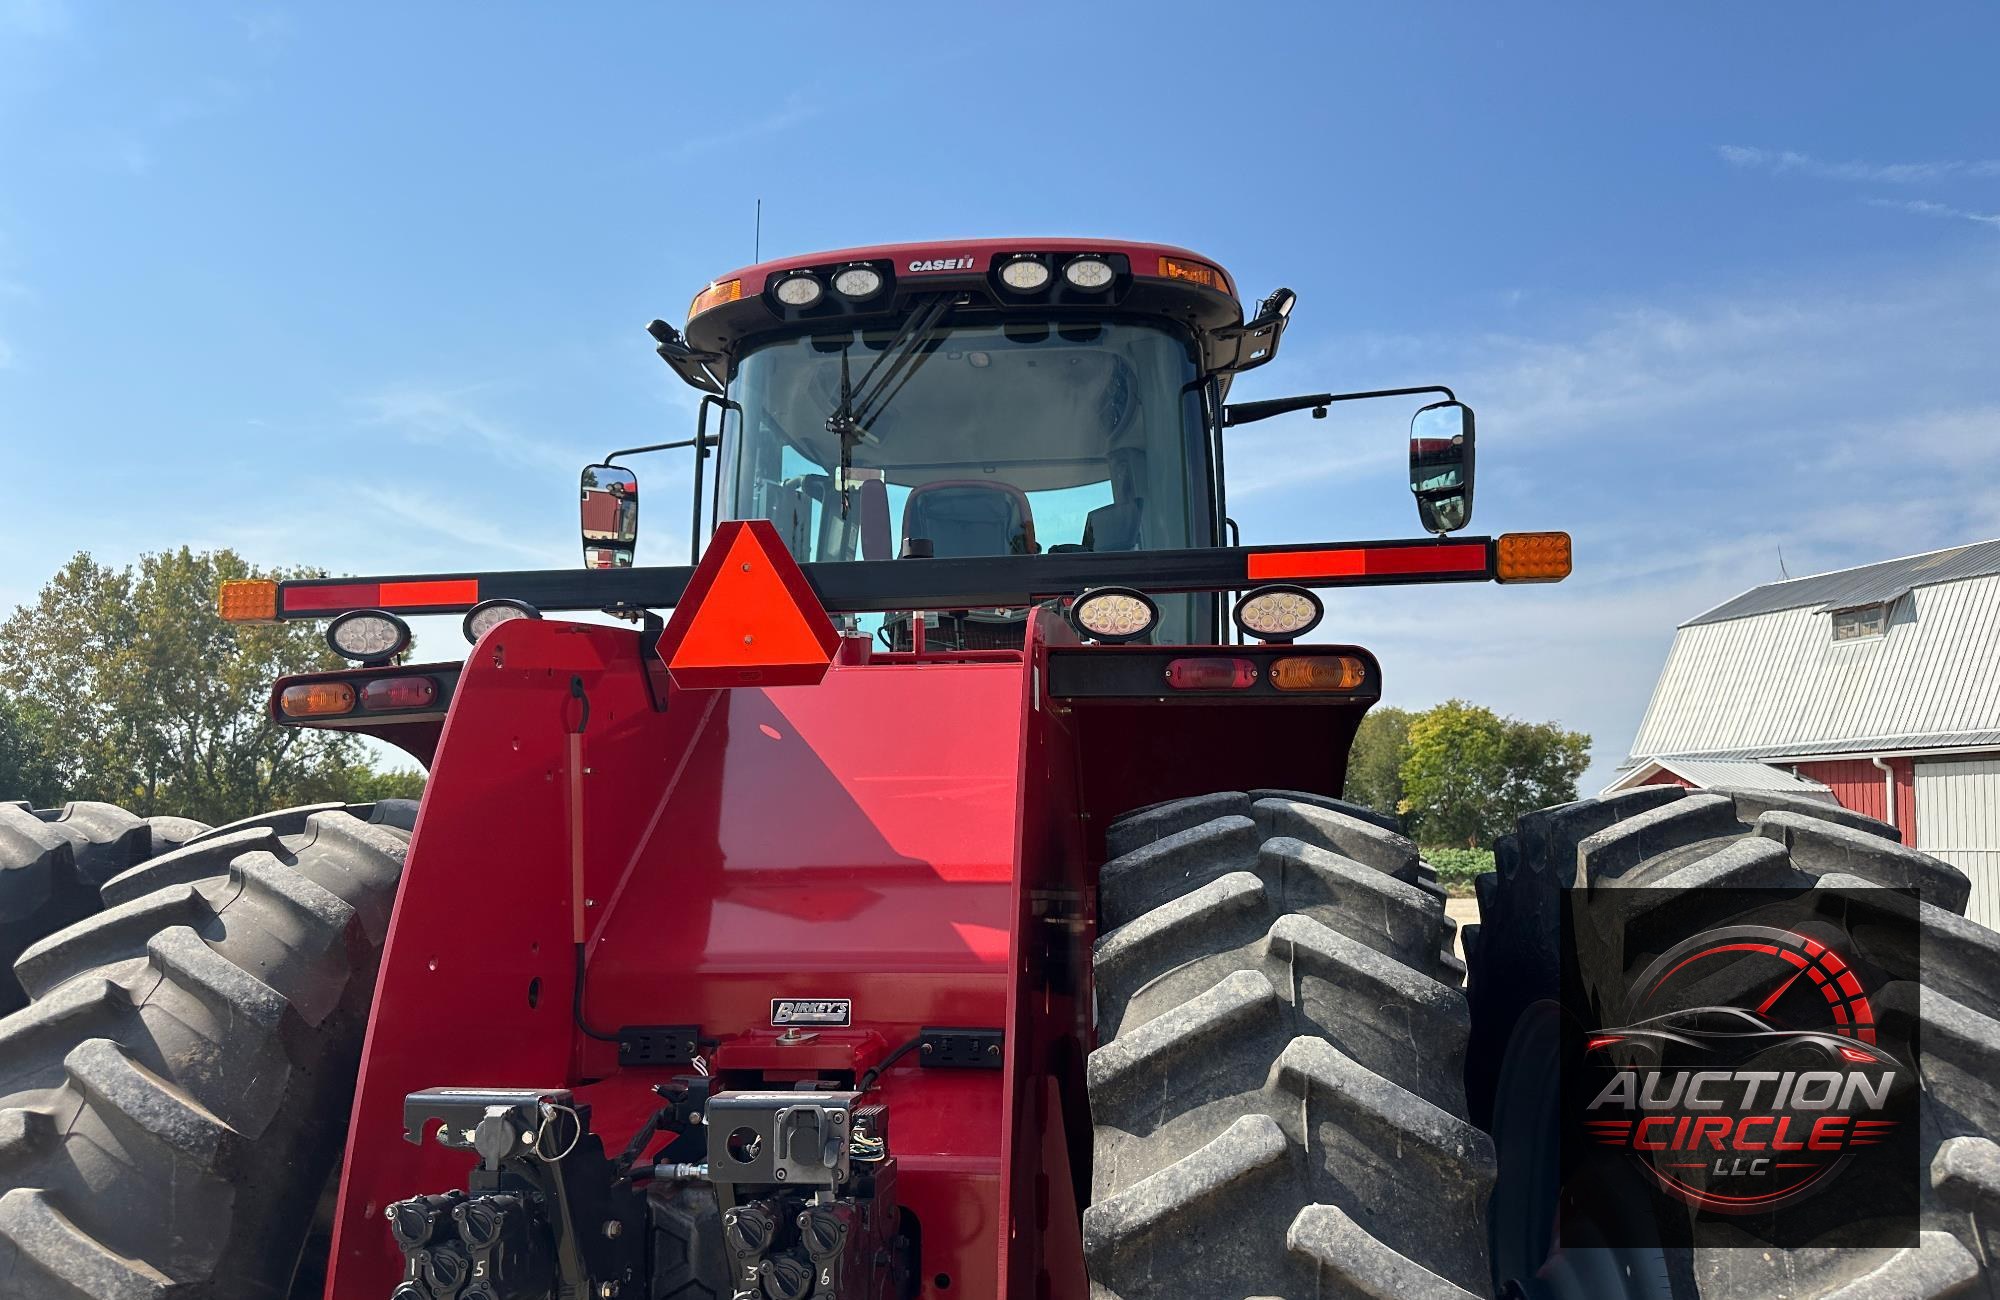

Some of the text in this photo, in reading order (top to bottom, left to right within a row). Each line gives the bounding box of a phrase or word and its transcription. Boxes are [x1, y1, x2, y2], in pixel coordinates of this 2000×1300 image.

[908, 260, 957, 272] CASE
[473, 1260, 486, 1277] 5
[745, 1265, 759, 1281] 3
[820, 1267, 830, 1286] 6
